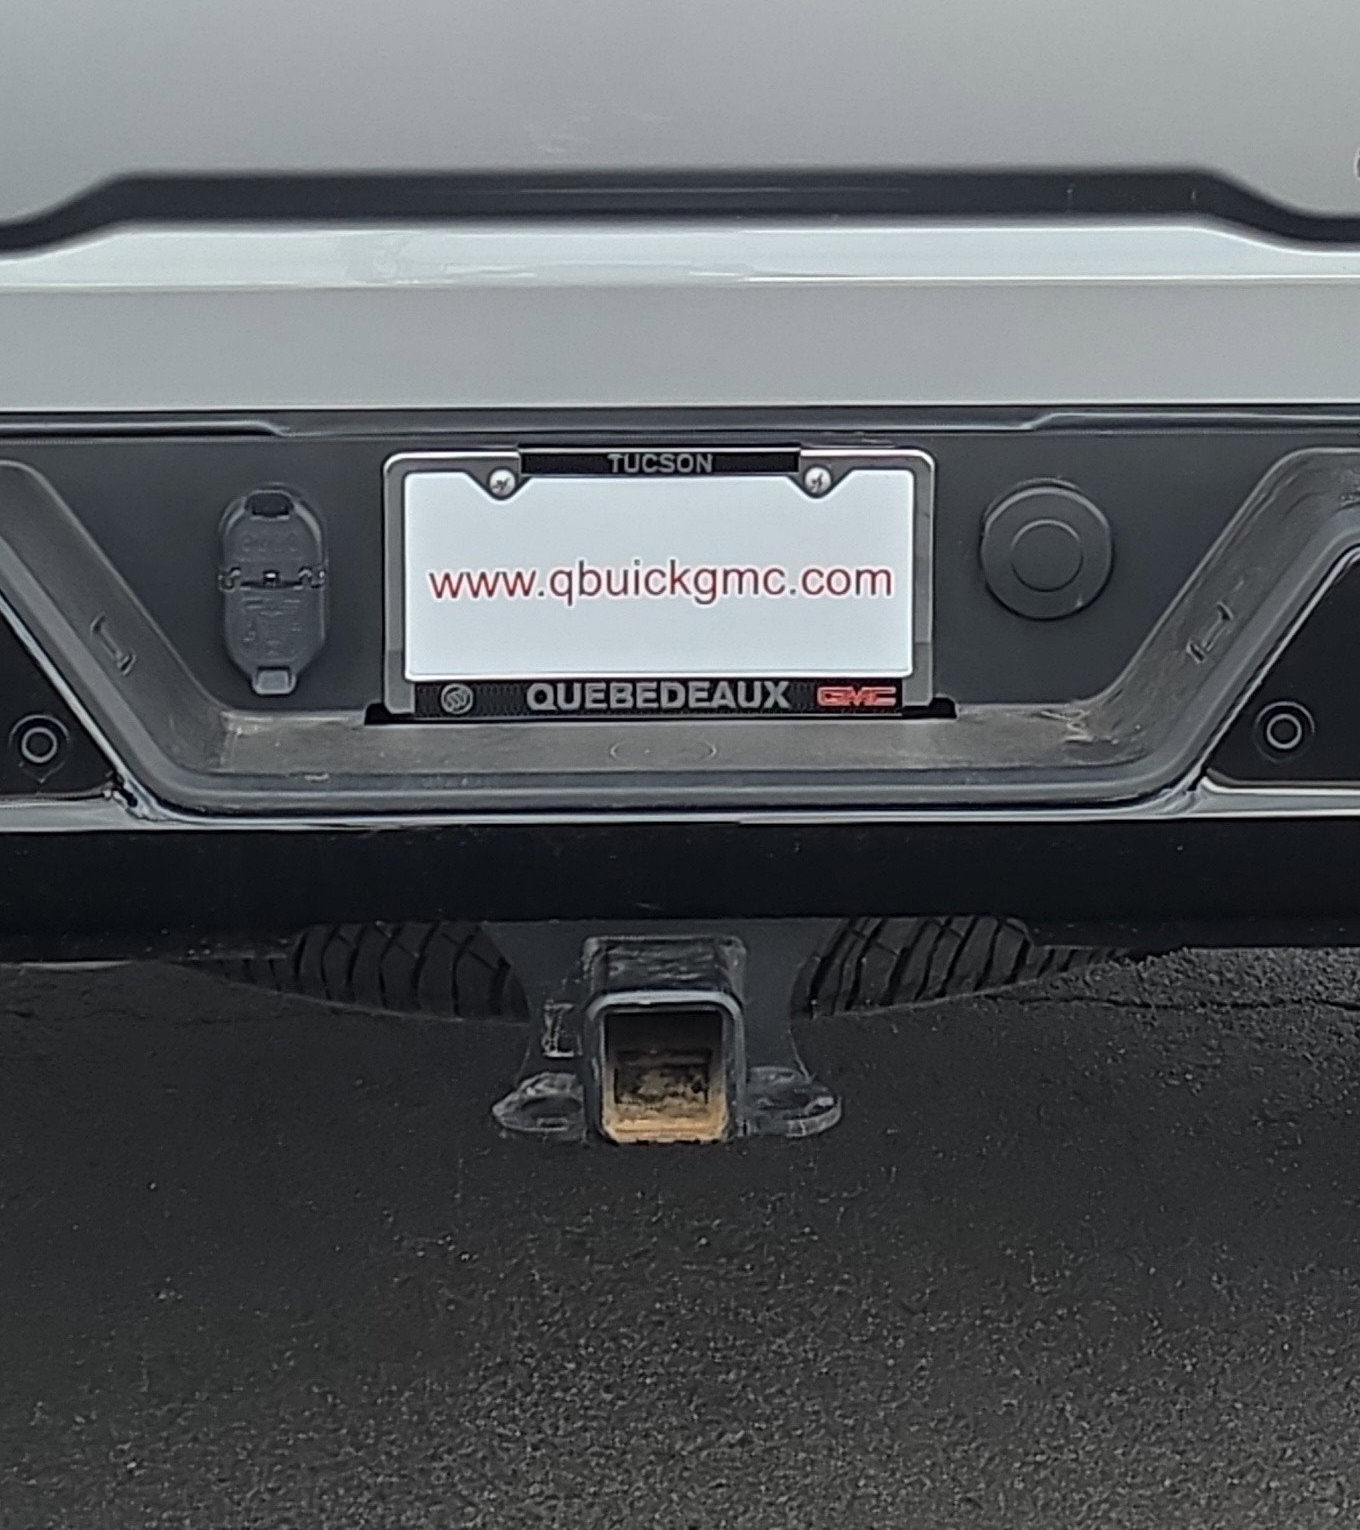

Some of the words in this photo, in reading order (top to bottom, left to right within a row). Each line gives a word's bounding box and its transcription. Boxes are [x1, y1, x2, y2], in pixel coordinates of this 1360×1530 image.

[607, 453, 714, 474] TUCSON
[428, 560, 894, 607] www.qbuickgmc.com
[526, 679, 791, 712] QUEBEDEAUX
[816, 685, 898, 708] GMC
